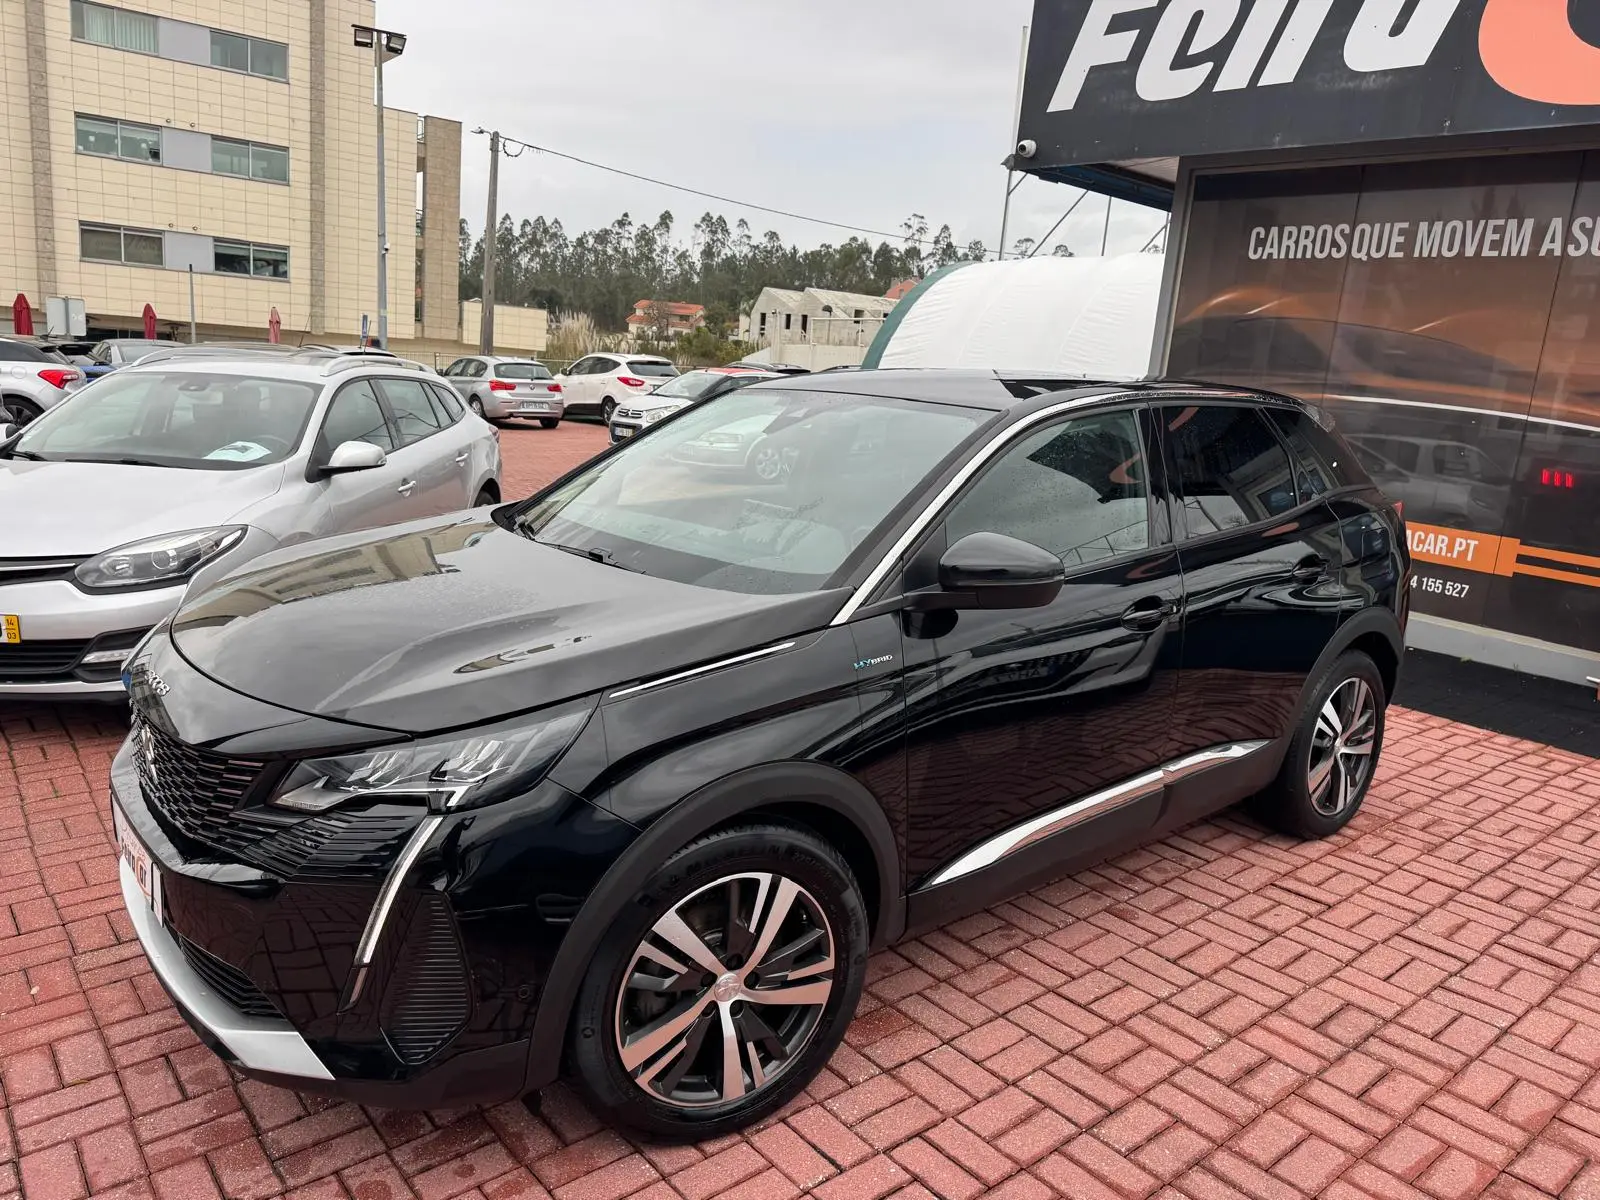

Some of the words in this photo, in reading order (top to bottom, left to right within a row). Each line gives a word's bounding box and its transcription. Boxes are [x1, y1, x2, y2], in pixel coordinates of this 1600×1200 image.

[1248, 224, 1350, 260] CARROS
[1351, 222, 1408, 261] QUE
[1413, 218, 1535, 258] MOVEM
[1538, 217, 1563, 257] A
[1421, 577, 1444, 594] 155
[1444, 581, 1470, 598] 527
[6, 632, 17, 640] 03
[853, 654, 893, 670] HYBRID
